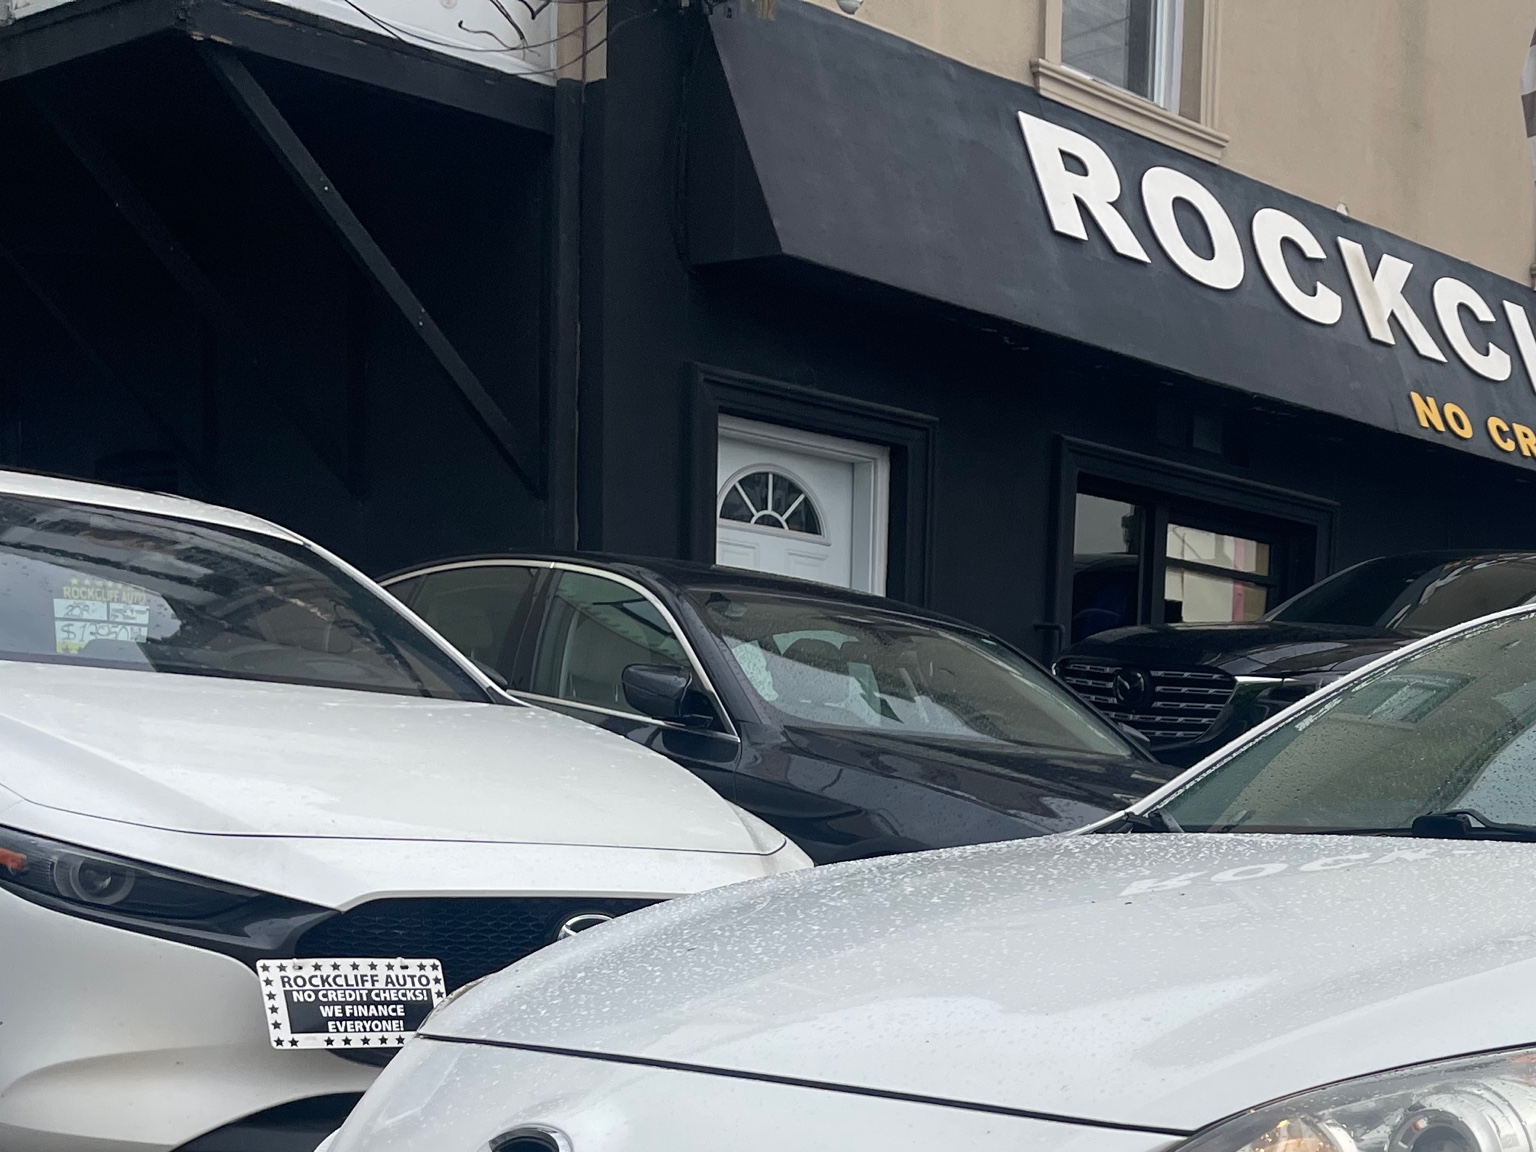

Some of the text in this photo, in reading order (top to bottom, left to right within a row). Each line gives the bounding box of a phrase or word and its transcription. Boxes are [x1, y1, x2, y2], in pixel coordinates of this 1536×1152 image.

[1410, 391, 1473, 439] NO
[63, 586, 147, 604] ROCKCLIFF AUTO
[280, 974, 431, 989] ROCKCLIFF AUTO
[293, 989, 428, 1002] NO CREDIT CHECKS!
[320, 1005, 405, 1018] WE FINANCE
[328, 1020, 405, 1032] EVERYONE!
